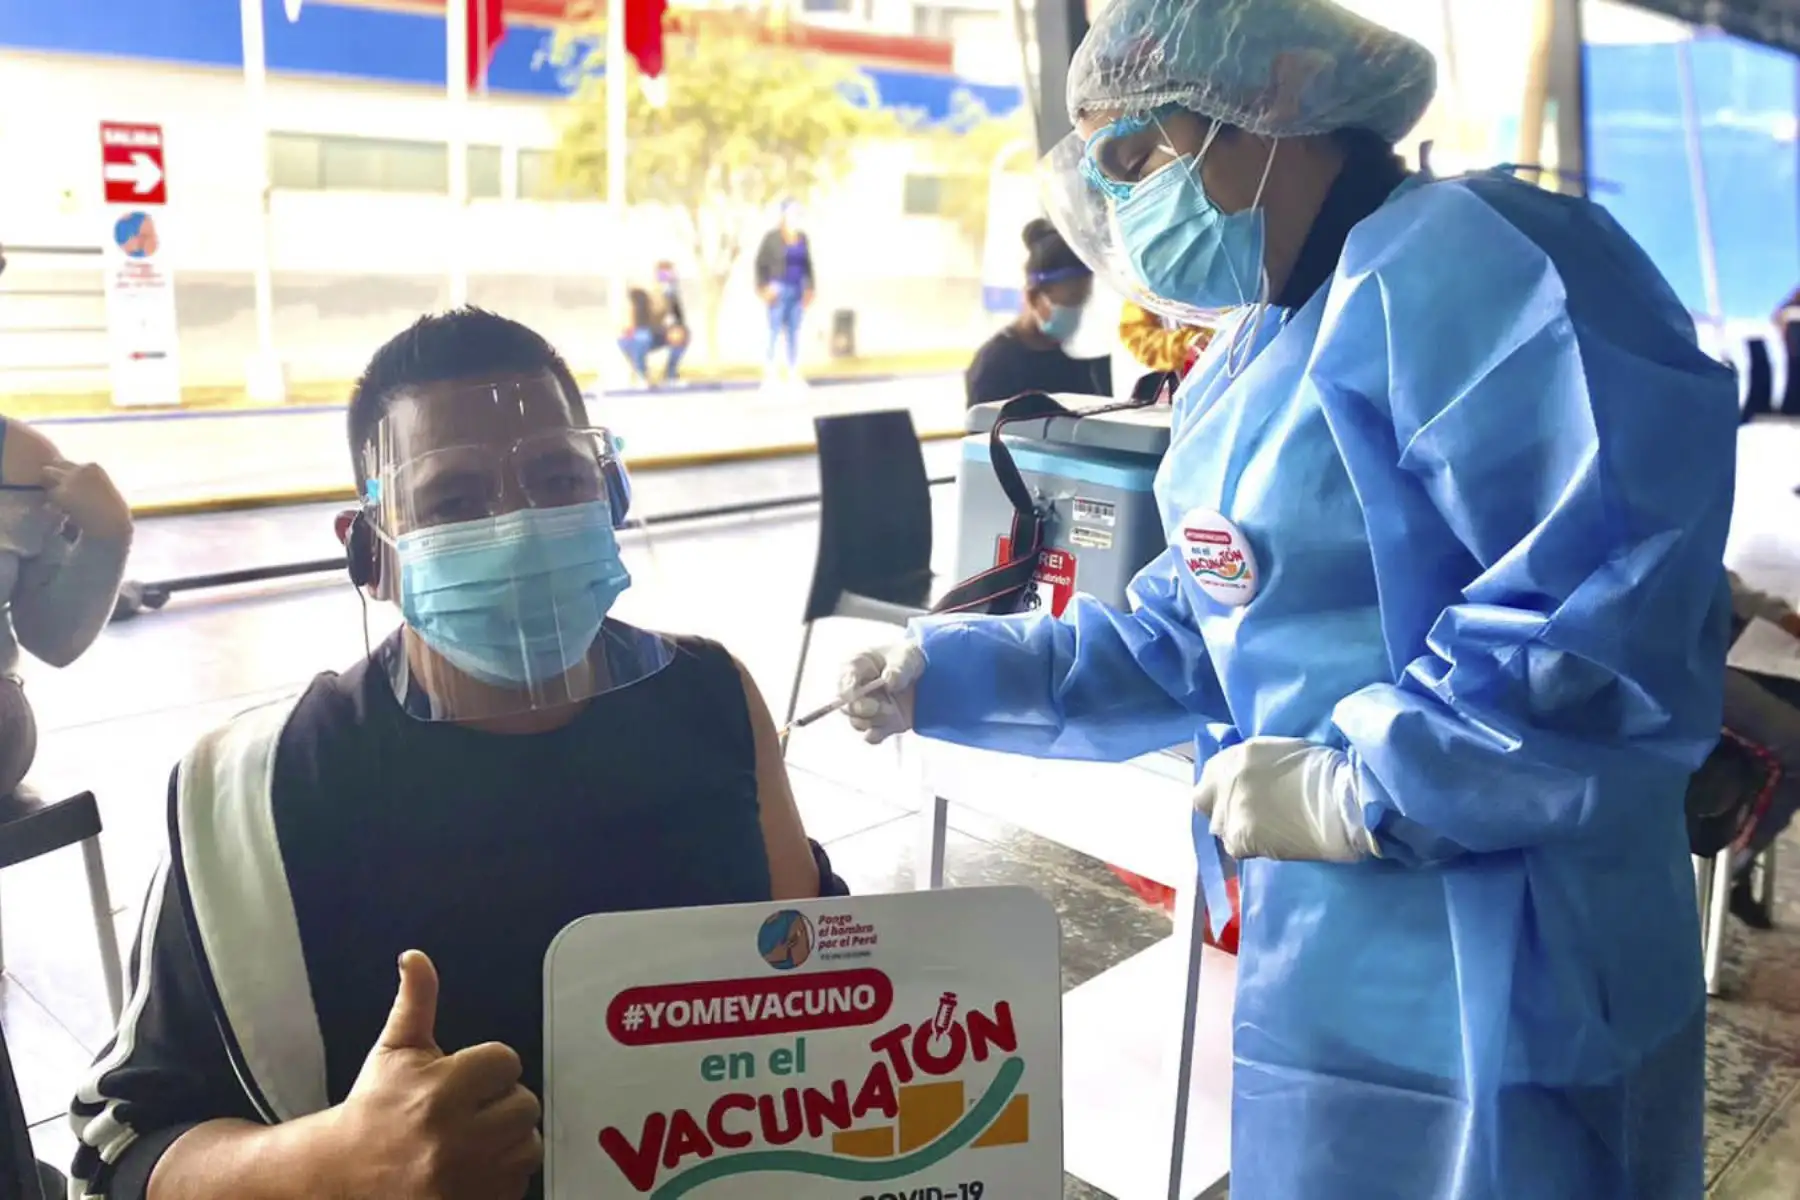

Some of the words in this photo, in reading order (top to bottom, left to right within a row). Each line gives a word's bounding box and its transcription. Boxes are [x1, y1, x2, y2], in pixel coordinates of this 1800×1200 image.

[818, 914, 852, 926] Pongo
[818, 926, 829, 937] el
[831, 923, 874, 936] hombro
[818, 939, 838, 951] por
[839, 936, 850, 948] el
[852, 935, 878, 946] Perú
[621, 984, 876, 1031] #YOMEVACUNO
[701, 1050, 755, 1082] en
[768, 1037, 806, 1076] el
[860, 1181, 984, 1200] VID-19
